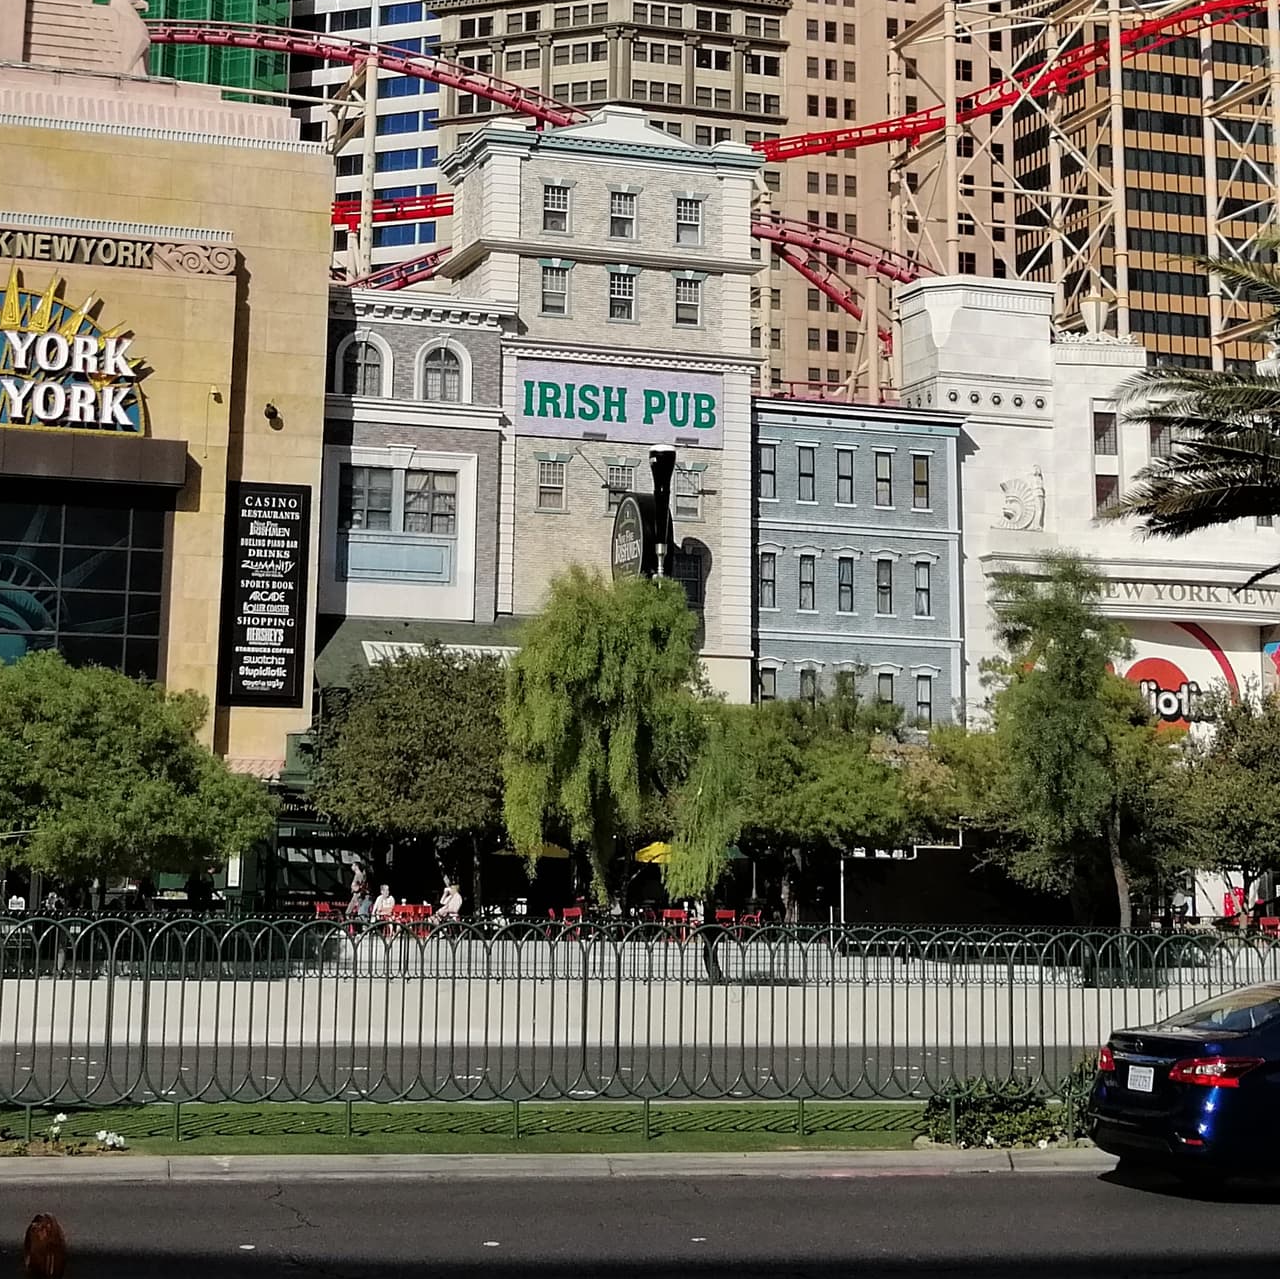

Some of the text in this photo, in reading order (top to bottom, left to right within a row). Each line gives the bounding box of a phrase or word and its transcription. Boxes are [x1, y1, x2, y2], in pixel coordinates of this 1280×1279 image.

[3, 330, 137, 377] YORK
[0, 378, 135, 426] YORK
[523, 380, 717, 429] IRISH PUB
[245, 496, 298, 509] CASINO
[241, 509, 300, 520] RESTAURANTS
[286, 540, 298, 549] BAR
[248, 548, 290, 559] DRINKS
[240, 579, 294, 590] SPORTS BOOK
[249, 590, 285, 602] ARCADE
[1154, 584, 1223, 604] YORK
[1228, 588, 1280, 606] NEW
[237, 616, 295, 627] SHOPPING
